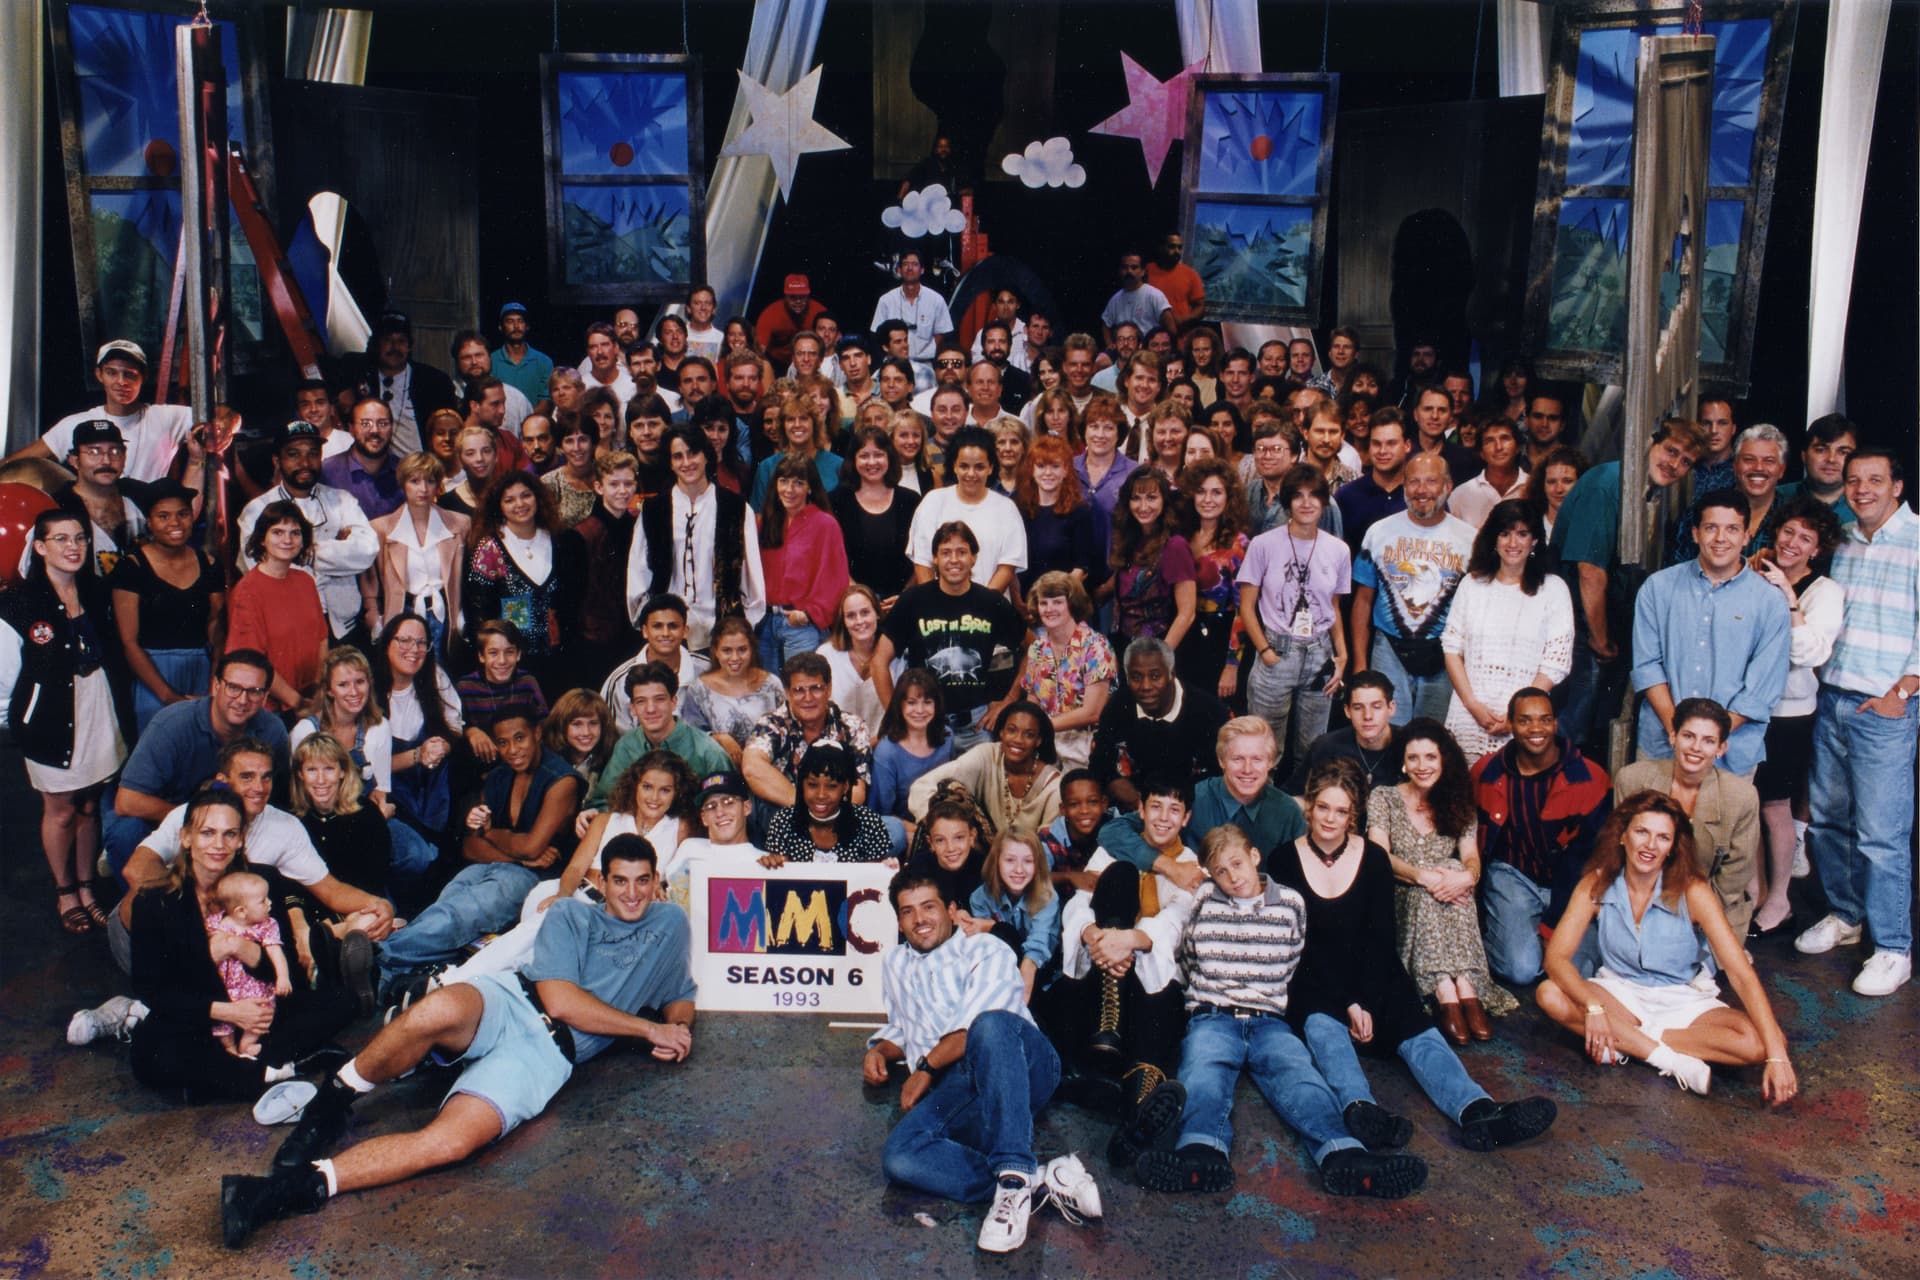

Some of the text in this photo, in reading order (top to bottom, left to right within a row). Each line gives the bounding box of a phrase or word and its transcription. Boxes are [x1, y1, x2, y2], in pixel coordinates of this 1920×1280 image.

[918, 618, 948, 637] LOST
[717, 887, 883, 955] MMC
[726, 965, 863, 986] SEASON 6
[773, 992, 820, 1007] 1993
